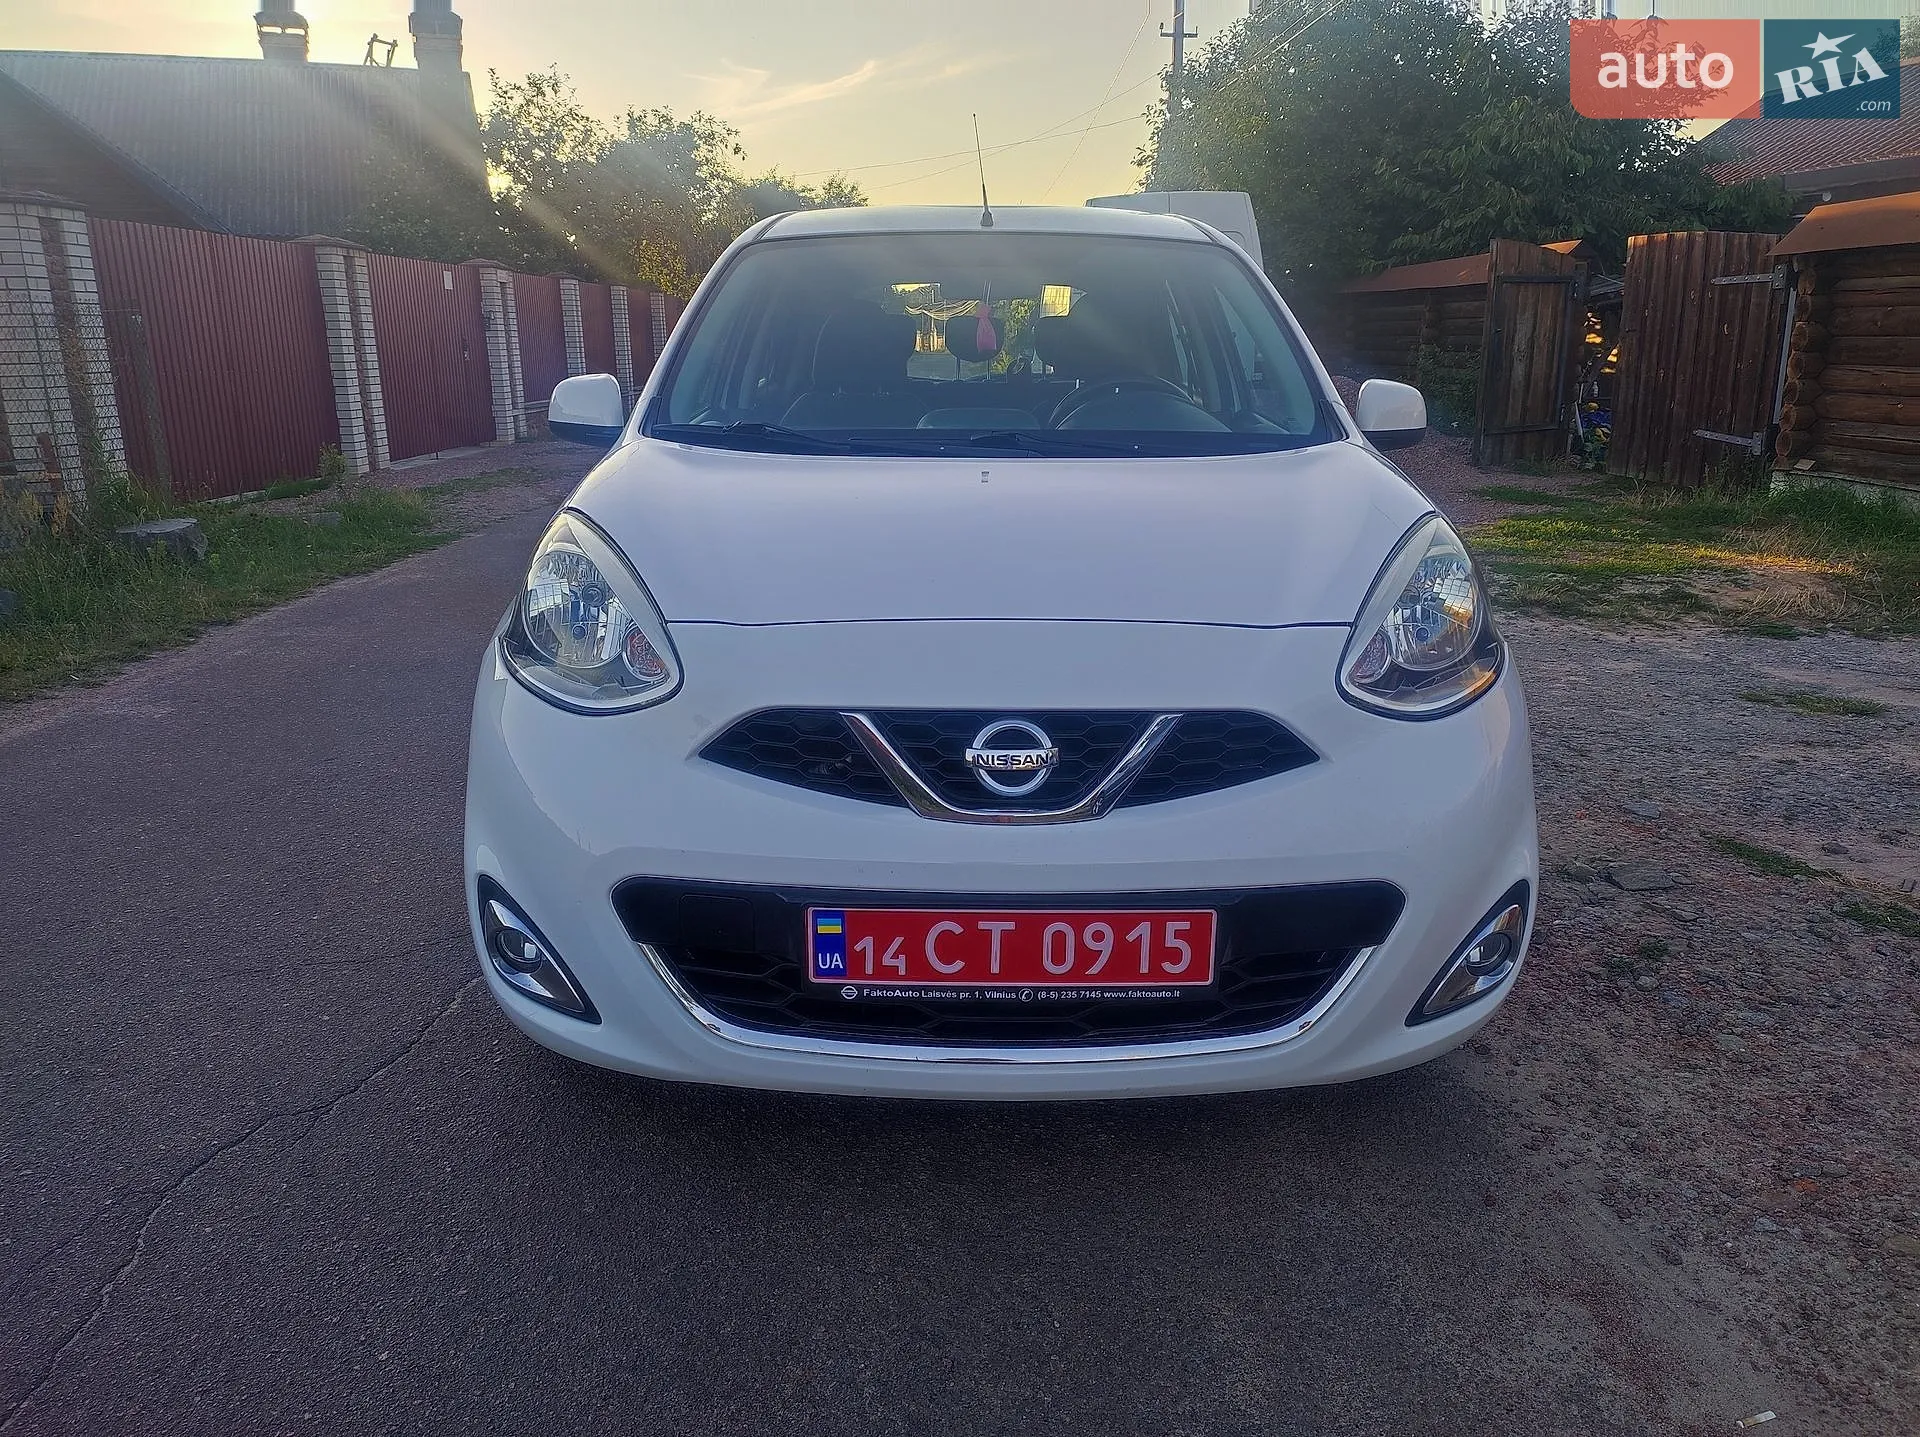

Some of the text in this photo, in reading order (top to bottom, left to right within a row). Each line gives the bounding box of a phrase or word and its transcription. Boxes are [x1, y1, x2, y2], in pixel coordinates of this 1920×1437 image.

[975, 753, 1050, 766] NISSAN
[853, 920, 1193, 976] 14 CT 0915
[818, 952, 844, 969] UA
[863, 988, 920, 998] FaktoAuto
[959, 991, 972, 1000] pr.
[974, 991, 983, 1000] 1,
[985, 990, 1017, 999] Vilnius
[1037, 990, 1059, 1000] (8-5)
[1061, 991, 1078, 999] 235
[1079, 991, 1102, 999] 7145
[1103, 989, 1181, 999] www.faktoauto.lt
